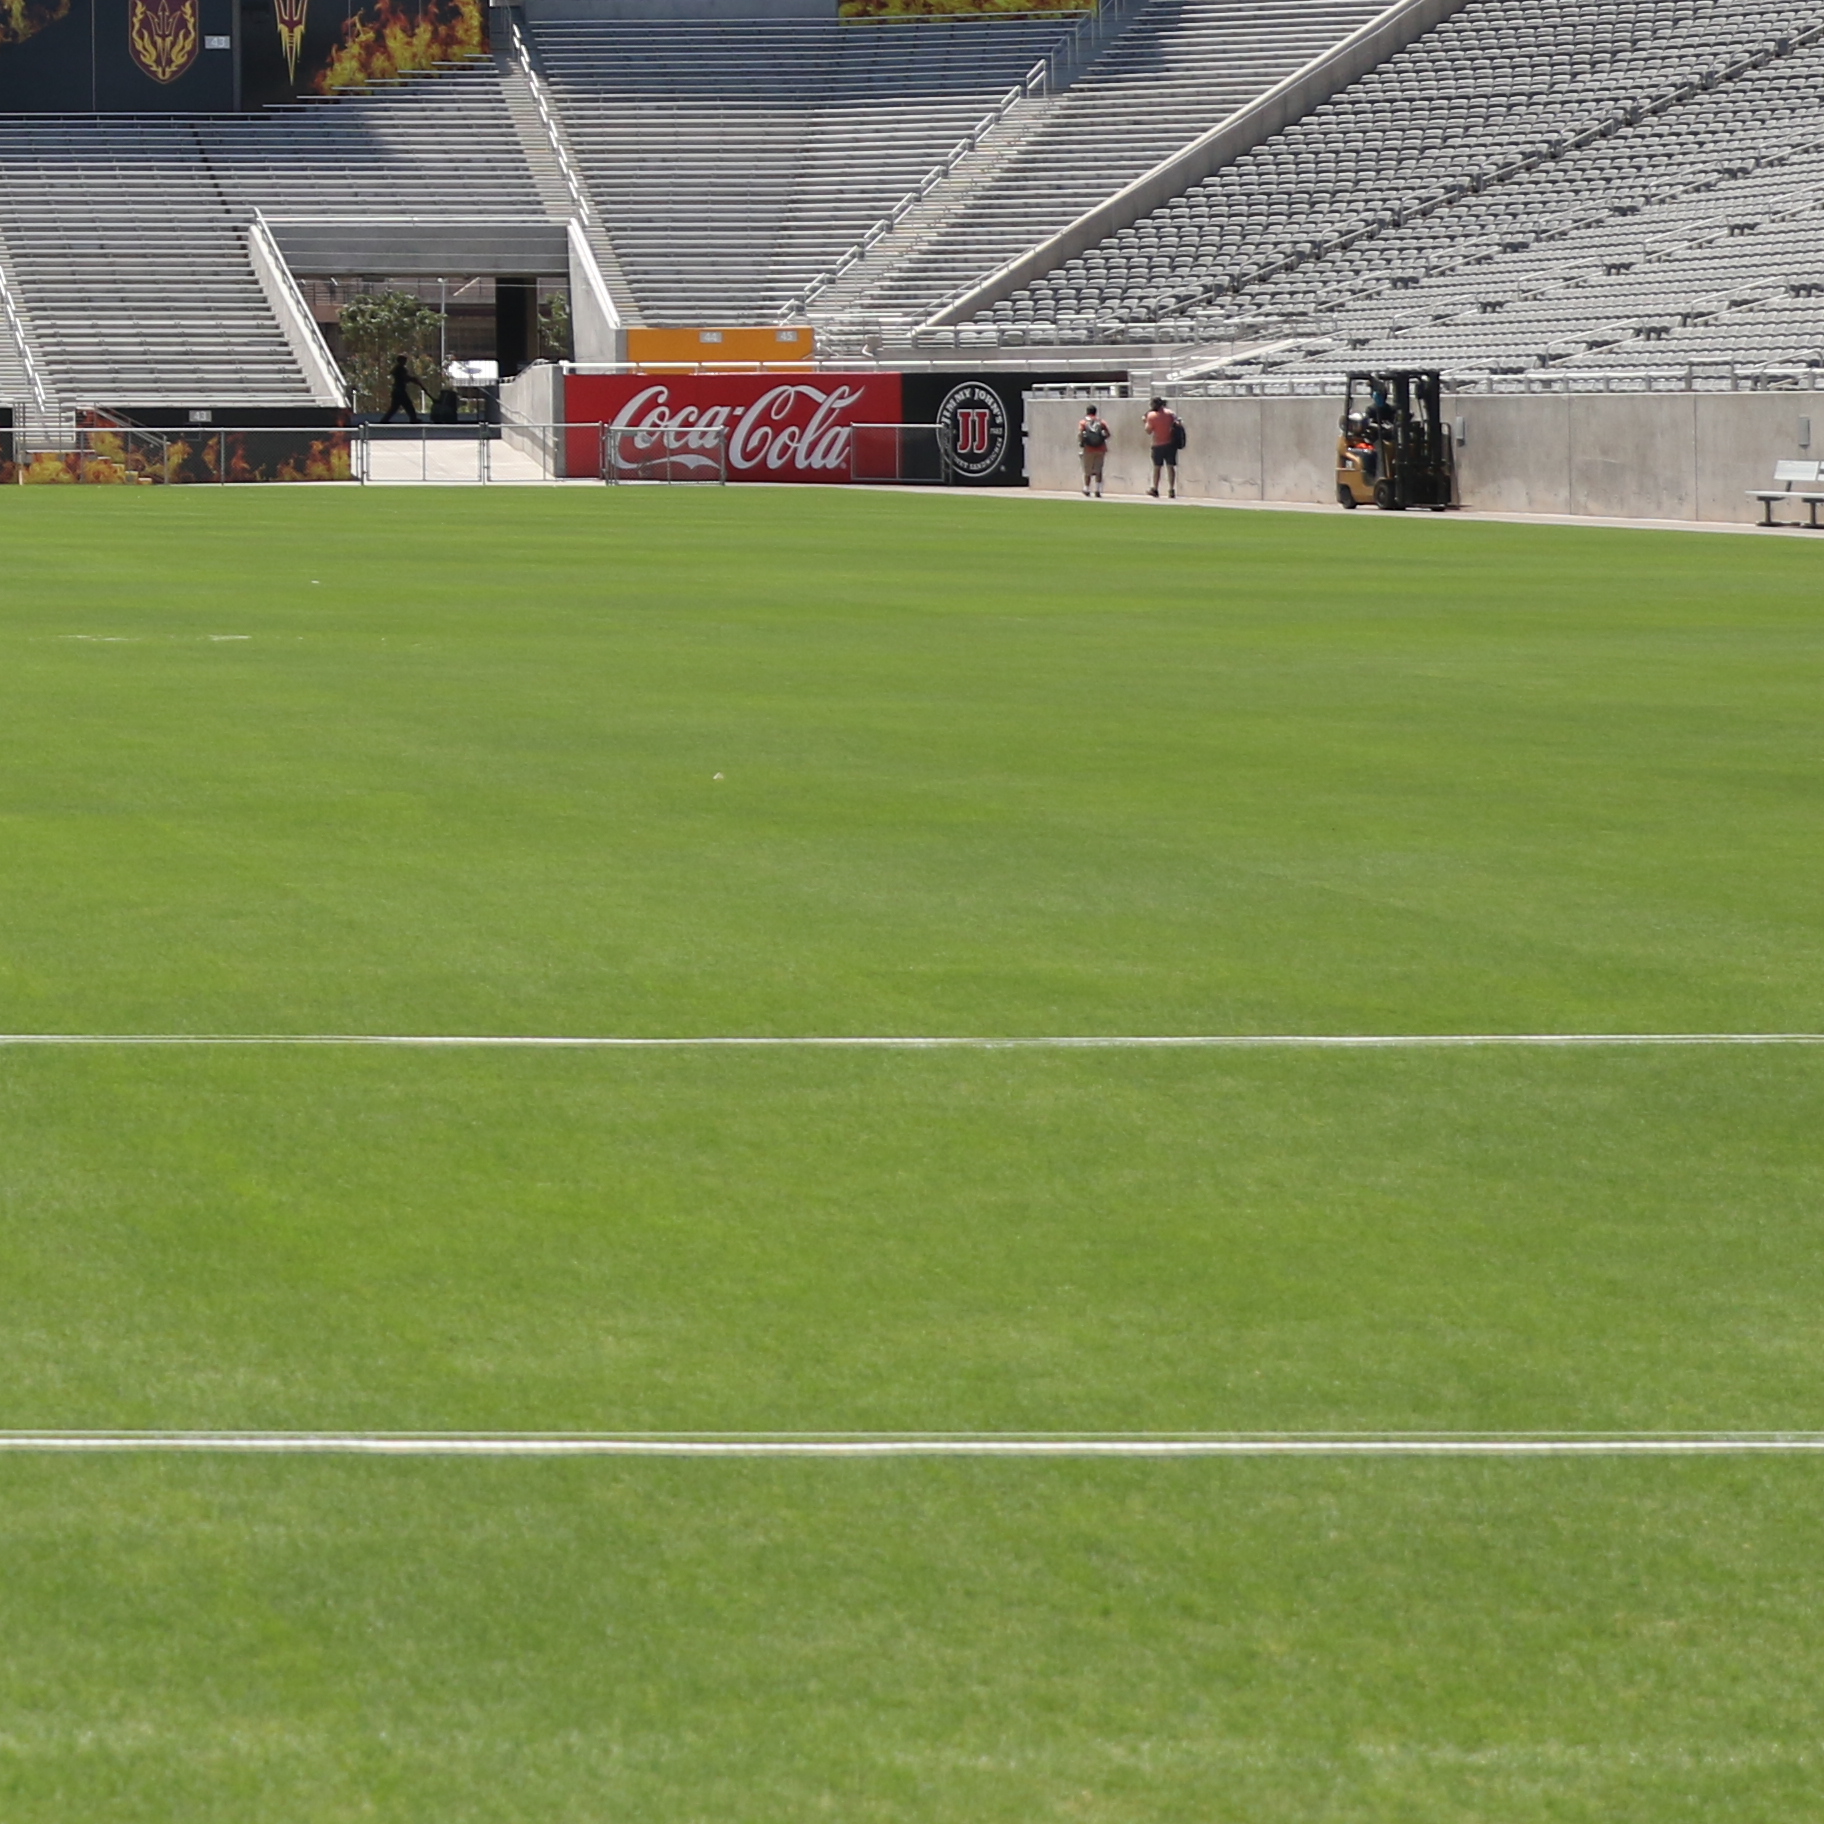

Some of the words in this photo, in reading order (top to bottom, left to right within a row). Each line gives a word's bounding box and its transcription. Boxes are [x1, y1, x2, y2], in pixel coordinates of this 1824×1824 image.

[611, 384, 865, 471] Coca-Cola
[941, 387, 972, 425] JIMMY
[973, 387, 1003, 424] JOHN'S
[957, 408, 989, 453] JJ
